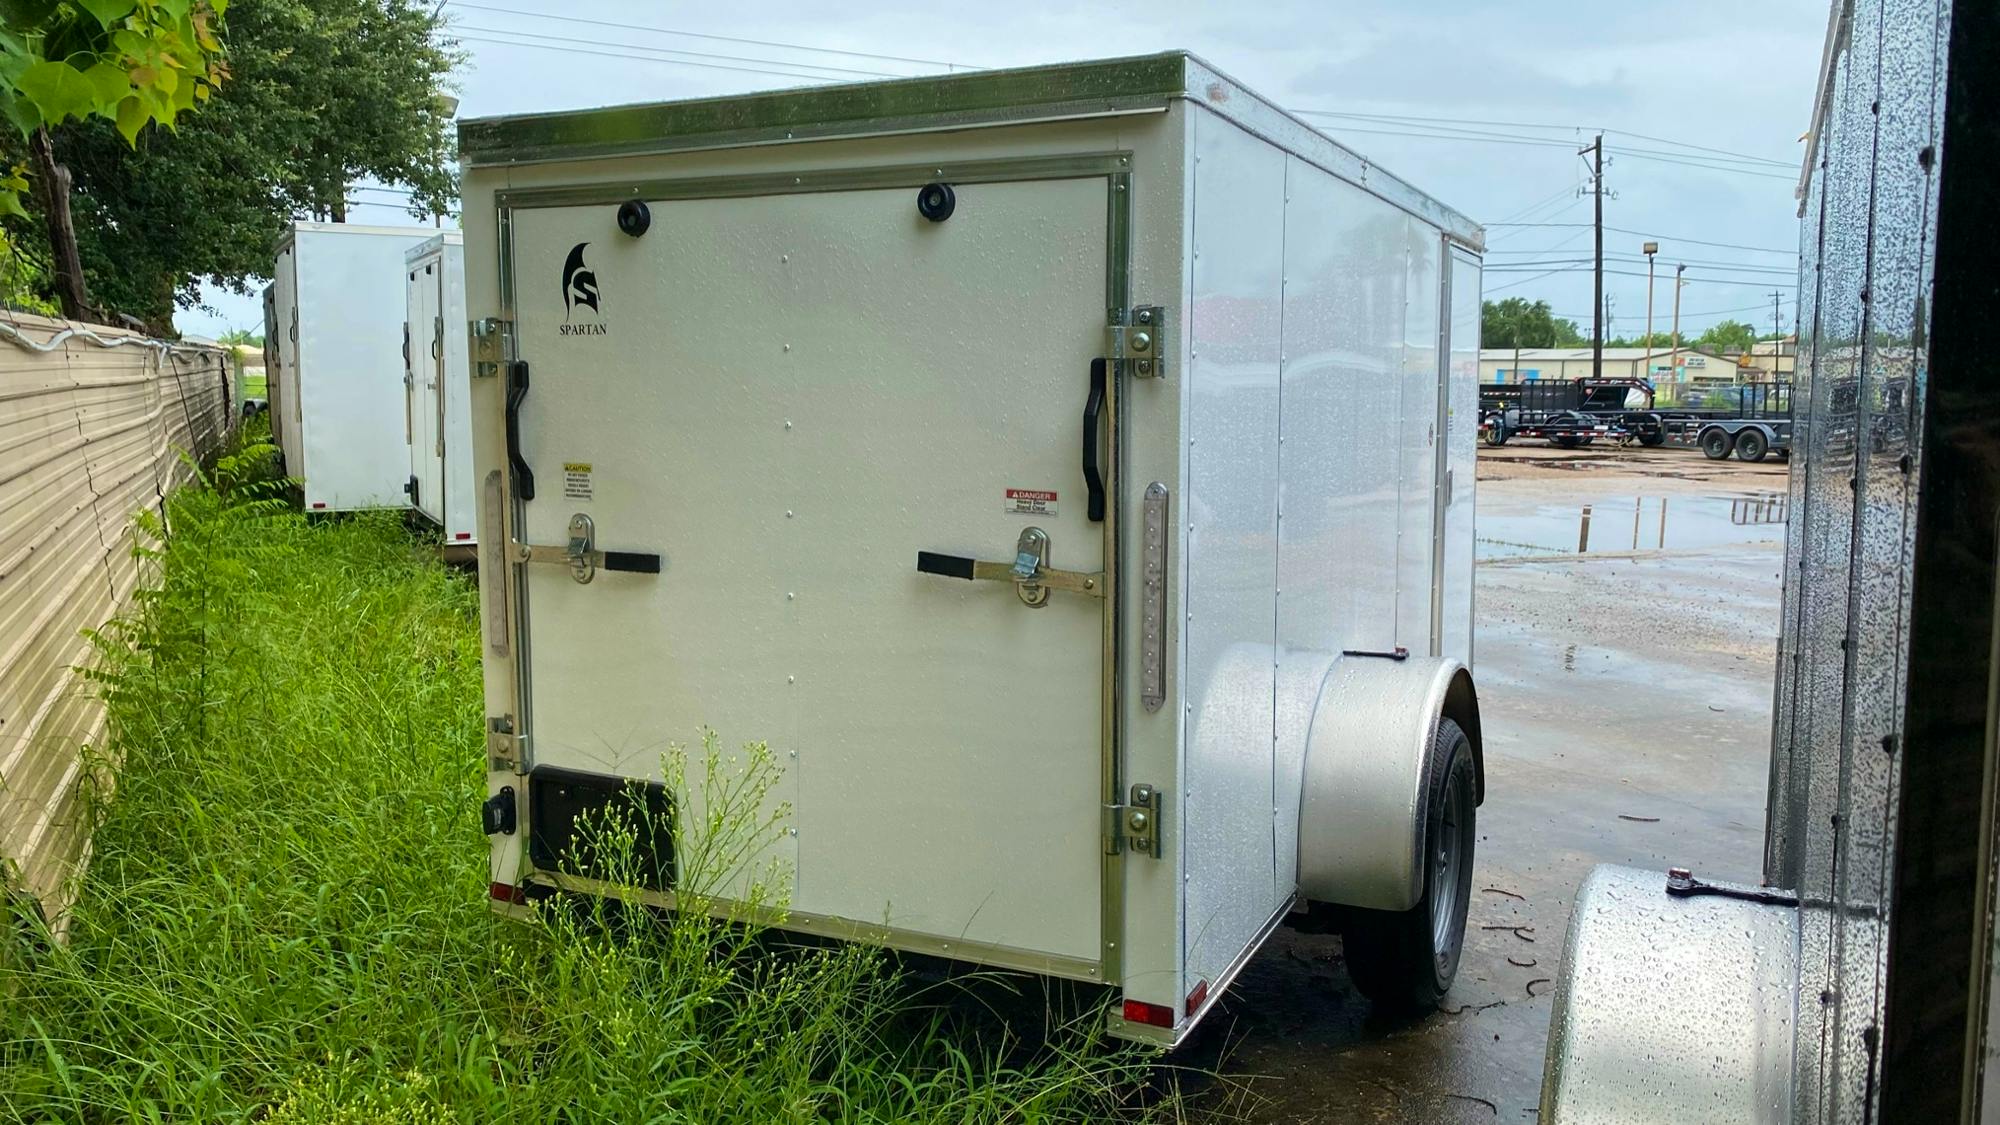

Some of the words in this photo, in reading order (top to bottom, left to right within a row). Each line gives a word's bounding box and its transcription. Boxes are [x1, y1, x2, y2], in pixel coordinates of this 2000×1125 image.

[559, 323, 607, 336] SPARTAN
[568, 464, 592, 472] CAUTION
[1019, 491, 1051, 500] DANGER
